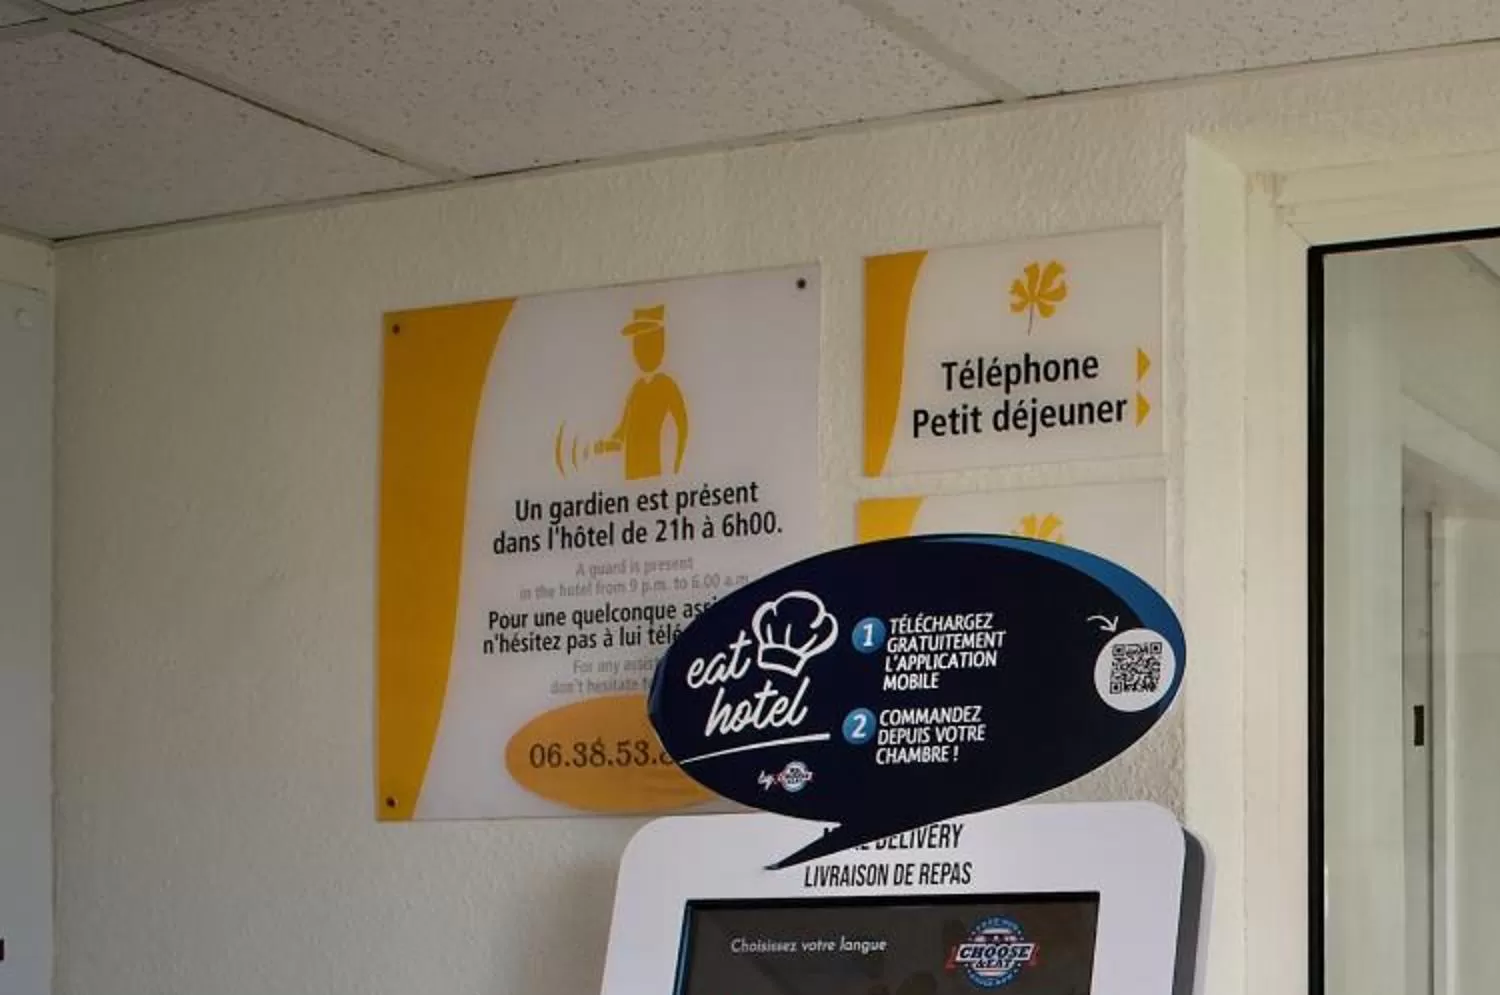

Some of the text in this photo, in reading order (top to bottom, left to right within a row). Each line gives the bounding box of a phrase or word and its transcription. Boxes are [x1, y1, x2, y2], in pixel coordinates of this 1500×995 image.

[941, 352, 1099, 395] Téléphone
[912, 398, 1128, 439] Petit déjeuner
[515, 481, 759, 525] Un gardien est présent
[493, 511, 783, 555] dans l'hôtel de 21h à 6h00.
[575, 562, 586, 577] A
[588, 560, 628, 579] guard
[643, 556, 694, 576] present
[559, 580, 593, 597] hotel
[594, 578, 627, 596] from
[488, 609, 528, 630] Pour
[533, 607, 567, 628] une
[571, 602, 678, 627] quelconque
[889, 612, 995, 635] TÉLÉCHARGEZ
[483, 630, 561, 655] n'hésitez
[567, 628, 598, 652] pas
[603, 625, 614, 648] à
[619, 625, 642, 647] lui
[862, 623, 874, 647] 1
[887, 630, 1007, 653] GRATUITEMENT
[686, 629, 752, 689] eat
[884, 650, 998, 673] L'APPLICATION
[882, 672, 941, 691] MOBILE
[704, 675, 811, 737] hotel
[879, 705, 983, 727] COMMANDEZ
[851, 713, 867, 739] 2
[877, 724, 987, 745] DEPUIS VOTRE
[875, 746, 950, 765] CHAMBRE
[804, 861, 973, 888] LIVRAISON DE REPAS
[730, 934, 888, 955] Choisissez votre langue
[959, 945, 1032, 959] CHOOSE
